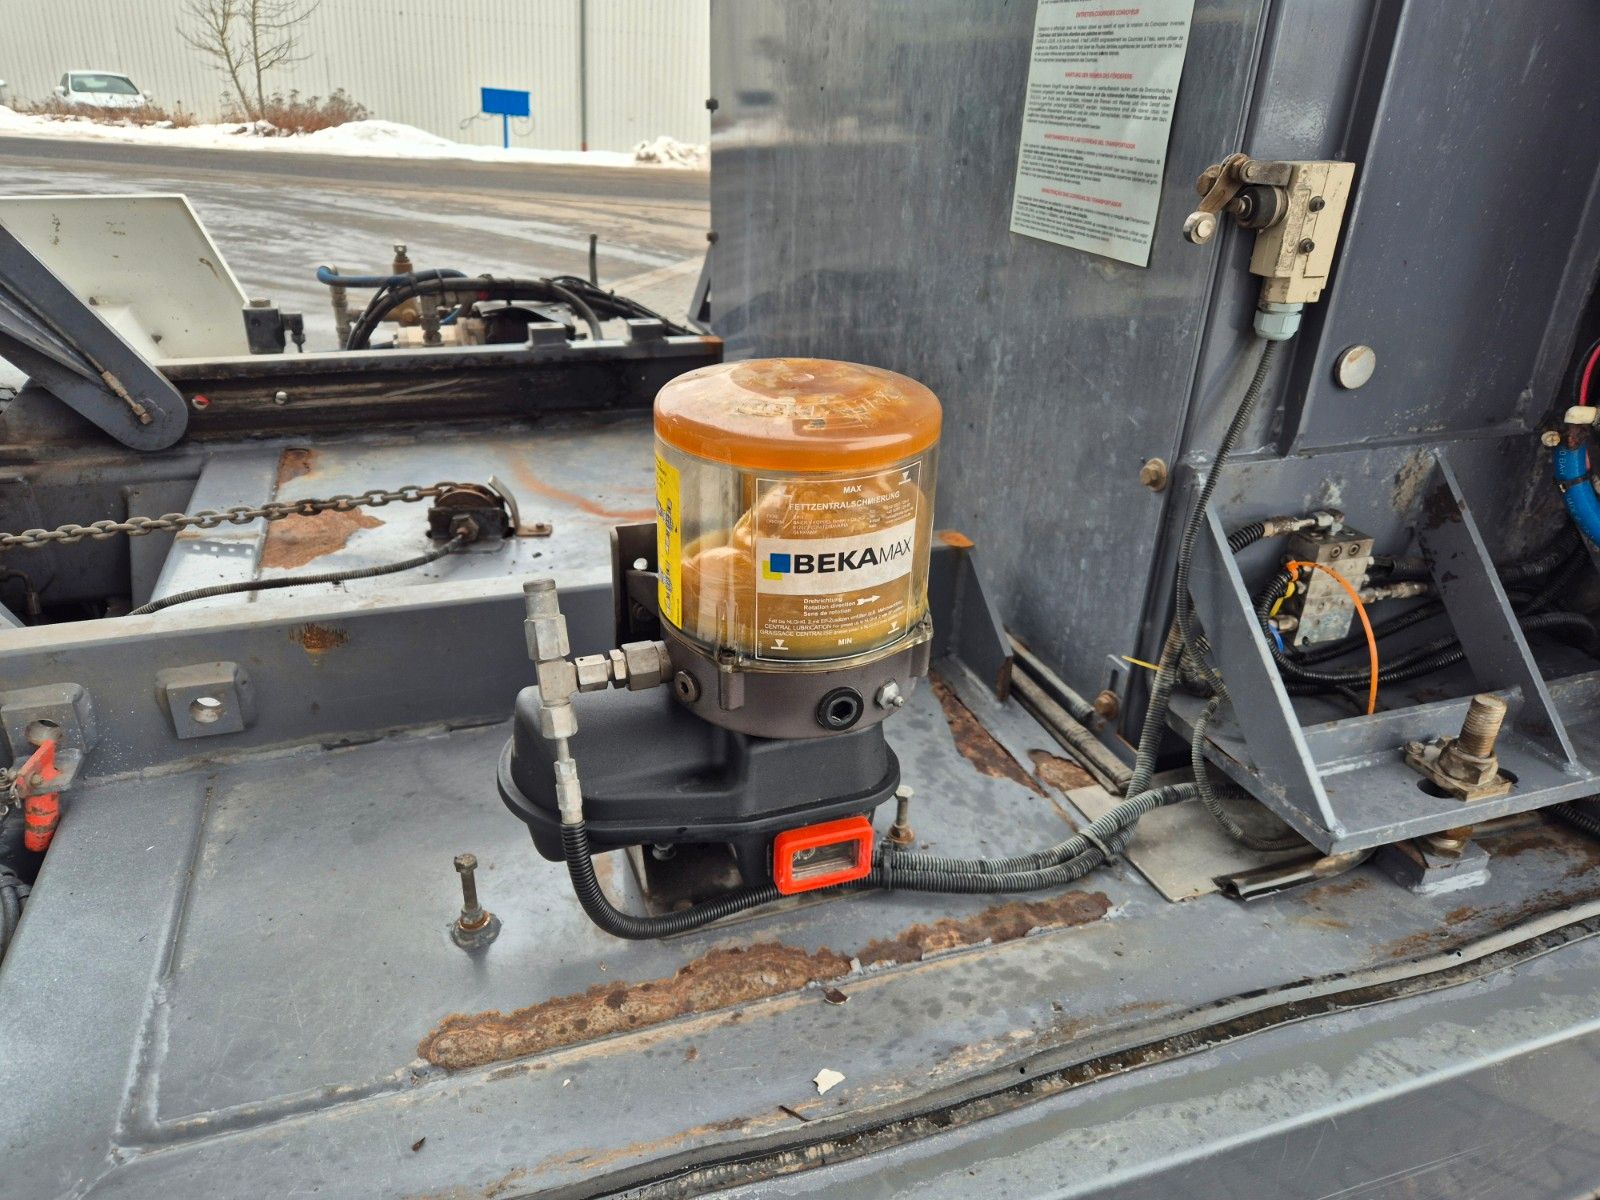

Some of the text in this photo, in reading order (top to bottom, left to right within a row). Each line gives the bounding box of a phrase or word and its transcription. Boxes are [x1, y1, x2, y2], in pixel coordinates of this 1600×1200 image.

[843, 485, 862, 495] MAX
[789, 490, 900, 511] FETTZENTRALSCHMIERUNG
[794, 536, 911, 574] BEKAMAX
[803, 596, 843, 604] Drehrichtung
[830, 601, 856, 609] direction
[838, 637, 853, 646] MIN
